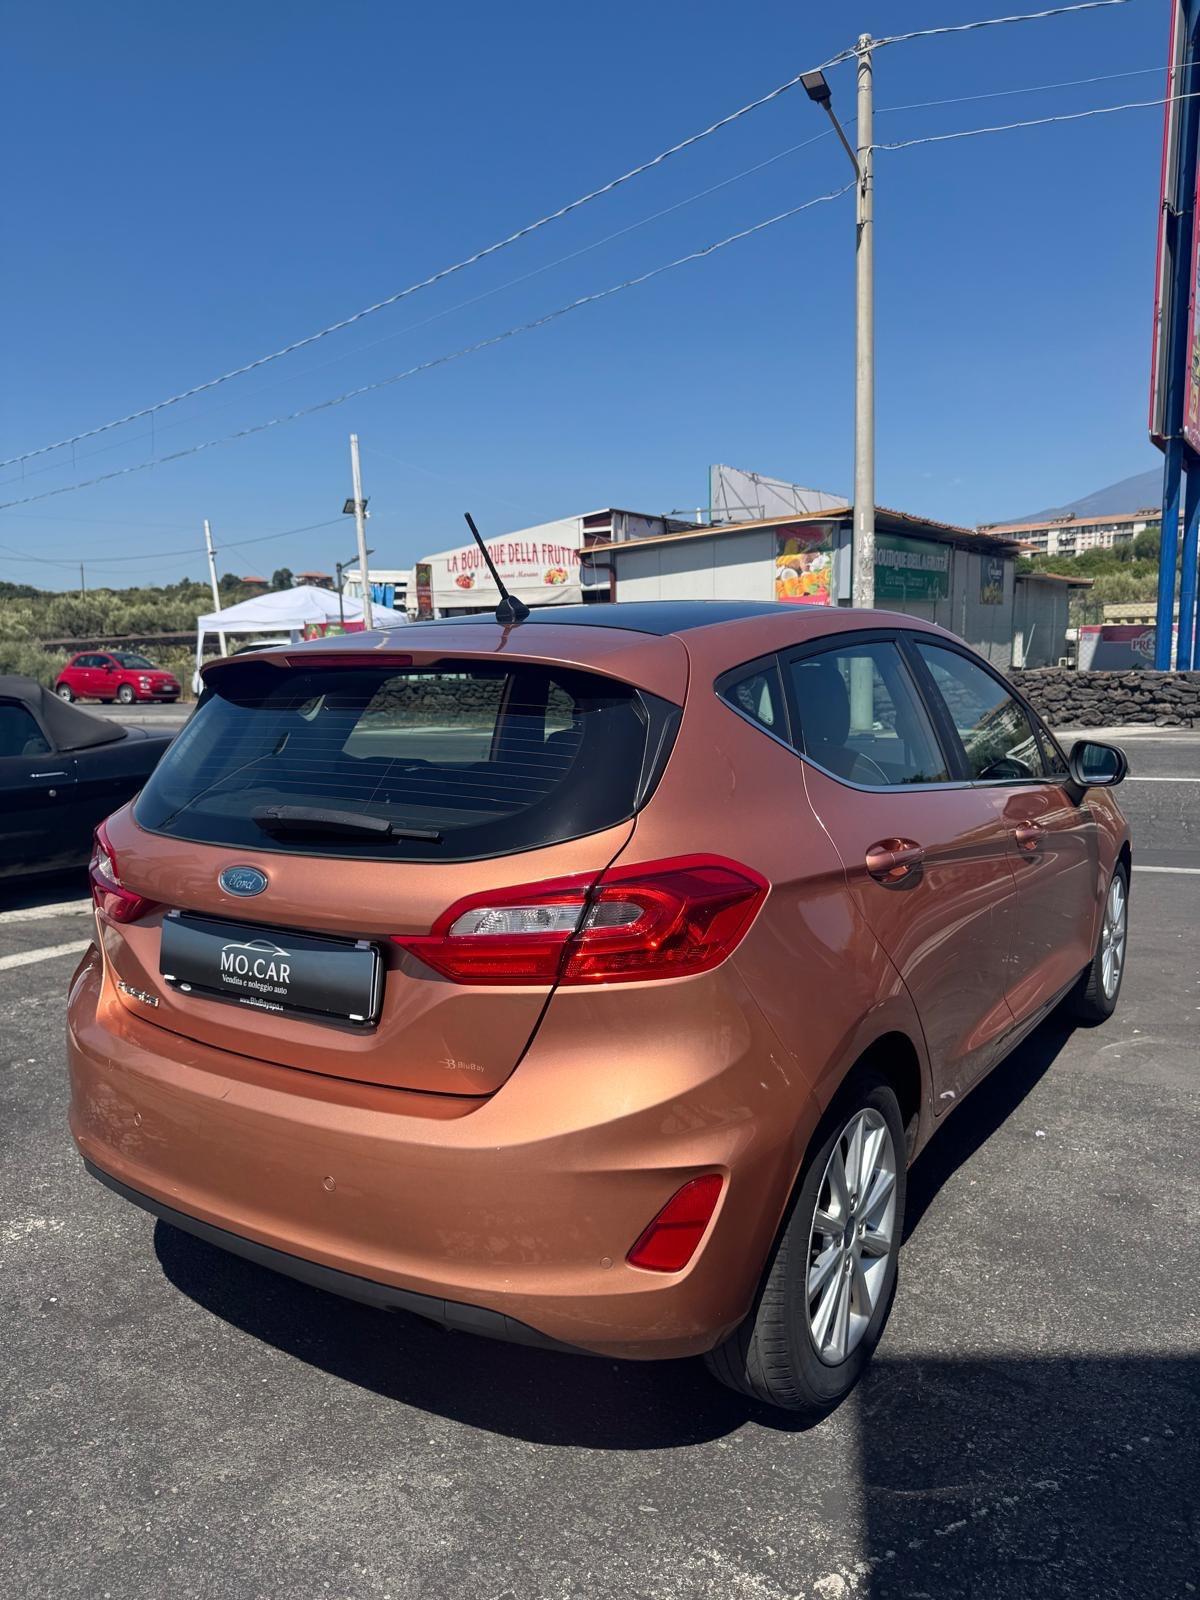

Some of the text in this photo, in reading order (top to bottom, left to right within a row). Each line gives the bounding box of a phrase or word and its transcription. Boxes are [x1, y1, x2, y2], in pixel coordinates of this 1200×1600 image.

[446, 542, 581, 573] LA BOUTQUE DELLA FRUTTA
[229, 873, 257, 890] Ford
[220, 951, 291, 984] MO.CAR
[222, 973, 243, 986] Vendita
[248, 980, 274, 993] noleggio
[274, 986, 288, 995] auto
